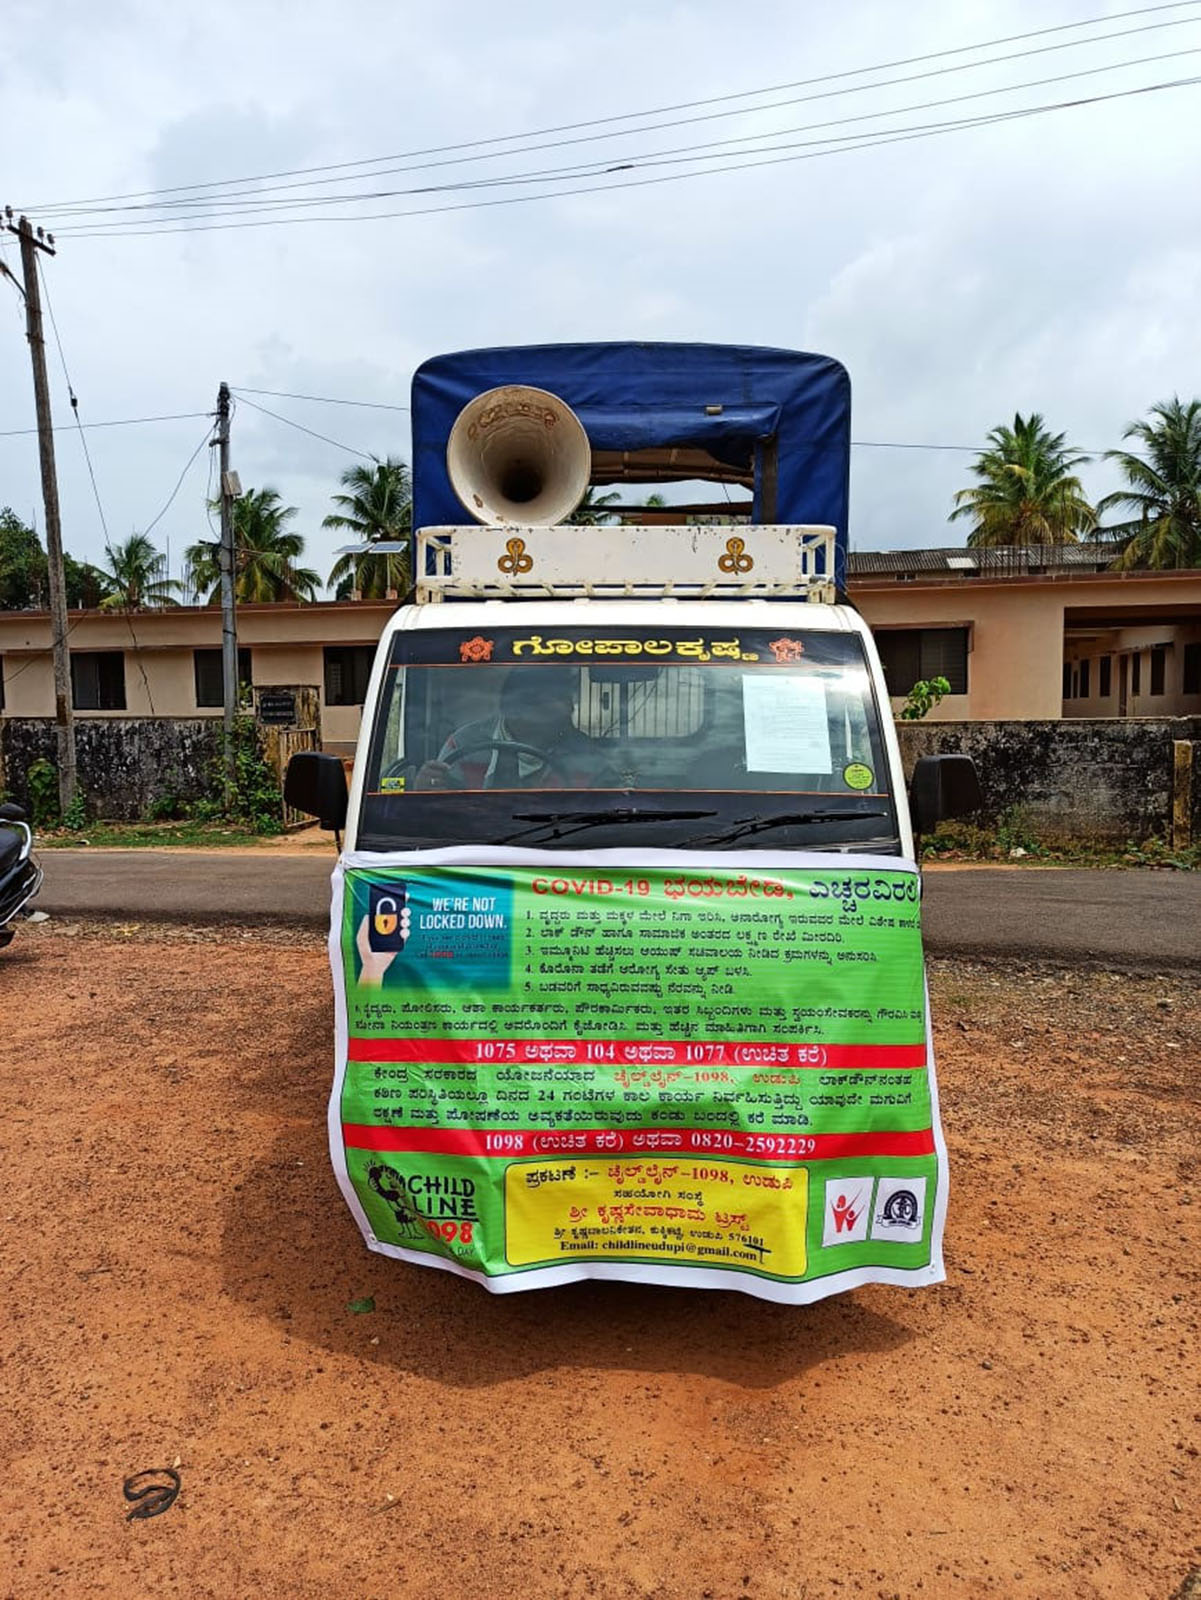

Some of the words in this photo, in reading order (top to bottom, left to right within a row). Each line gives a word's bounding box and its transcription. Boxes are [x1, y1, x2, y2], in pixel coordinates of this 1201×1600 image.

[512, 635, 760, 661] ಗೋಪಾಲಕೃಷ್ಣ
[531, 877, 651, 897] COVID-19
[664, 875, 794, 900] ಭಯಬೇಡ,
[432, 896, 470, 912] WE'RE
[473, 896, 497, 912] NOT
[419, 913, 466, 930] LOCKED
[468, 913, 508, 930] DOWN.
[525, 910, 535, 921] 1.
[576, 910, 602, 925] ಮತ್ತು
[639, 909, 667, 921] ಮೇಲೆ
[838, 913, 865, 927] ಮೇಲೆ
[525, 927, 535, 939] 2.
[540, 926, 564, 939] ಲಾಕ್
[525, 944, 534, 956] 3.
[524, 963, 534, 974] 4.
[524, 981, 534, 992] 5.
[663, 1004, 690, 1016] ಇತರ
[758, 1006, 788, 1022] ಮತ್ತು
[635, 1021, 664, 1037] ಮತ್ತು
[475, 1042, 517, 1060] 1075
[524, 1042, 577, 1062] ಅಥವಾ
[586, 1043, 616, 1060] 104
[624, 1043, 677, 1062] ಅಥವಾ
[685, 1044, 726, 1061] 1077
[734, 1045, 790, 1064] (ಉಚಿತ
[797, 1045, 828, 1066] ಕರೆ)
[373, 1067, 409, 1083] ಕೇಂದ್ರ
[423, 1068, 478, 1082] ಸರಕಾರದ
[495, 1068, 596, 1082] ಯೋಜನೆಯಾದ
[751, 1073, 801, 1086] ಉಡುಪಿ
[495, 1088, 530, 1101] ದಿನದ
[536, 1089, 556, 1101] 24
[561, 1088, 616, 1102] ಗಂಟೆಗಳ
[622, 1090, 651, 1103] ಕಾಲ
[658, 1090, 706, 1103] ಕಾರ್ಯ
[808, 1093, 863, 1108] ಯಾವುದೇ
[868, 1092, 913, 1105] ಮಗುವಿಗೆ
[373, 1107, 404, 1124] ರಕ್ಷಣೆ
[410, 1107, 441, 1125] ಮತ್ತು
[650, 1109, 686, 1121] ಕಂಡು
[693, 1110, 741, 1127] ಬಂದಲ್ಲಿ
[747, 1111, 766, 1125] ಕರೆ
[485, 1133, 524, 1151] 1098
[532, 1134, 588, 1152] (ಉಚಿತ
[595, 1131, 625, 1151] ಕರೆ)
[631, 1132, 683, 1149] ಅಥವಾ
[690, 1131, 817, 1154] 0820-2592229
[407, 1174, 476, 1198] CHILD
[525, 1165, 577, 1189] ಪ್ರಕಟಣೆ
[742, 1172, 793, 1191] ಉಡುಪಿ
[411, 1195, 478, 1217] LINE
[568, 1205, 589, 1223] ಶ್ರೀ
[727, 1231, 765, 1248] 576101
[559, 1240, 599, 1251] Email:
[602, 1239, 758, 1261] childlineudupi@gmail.com
